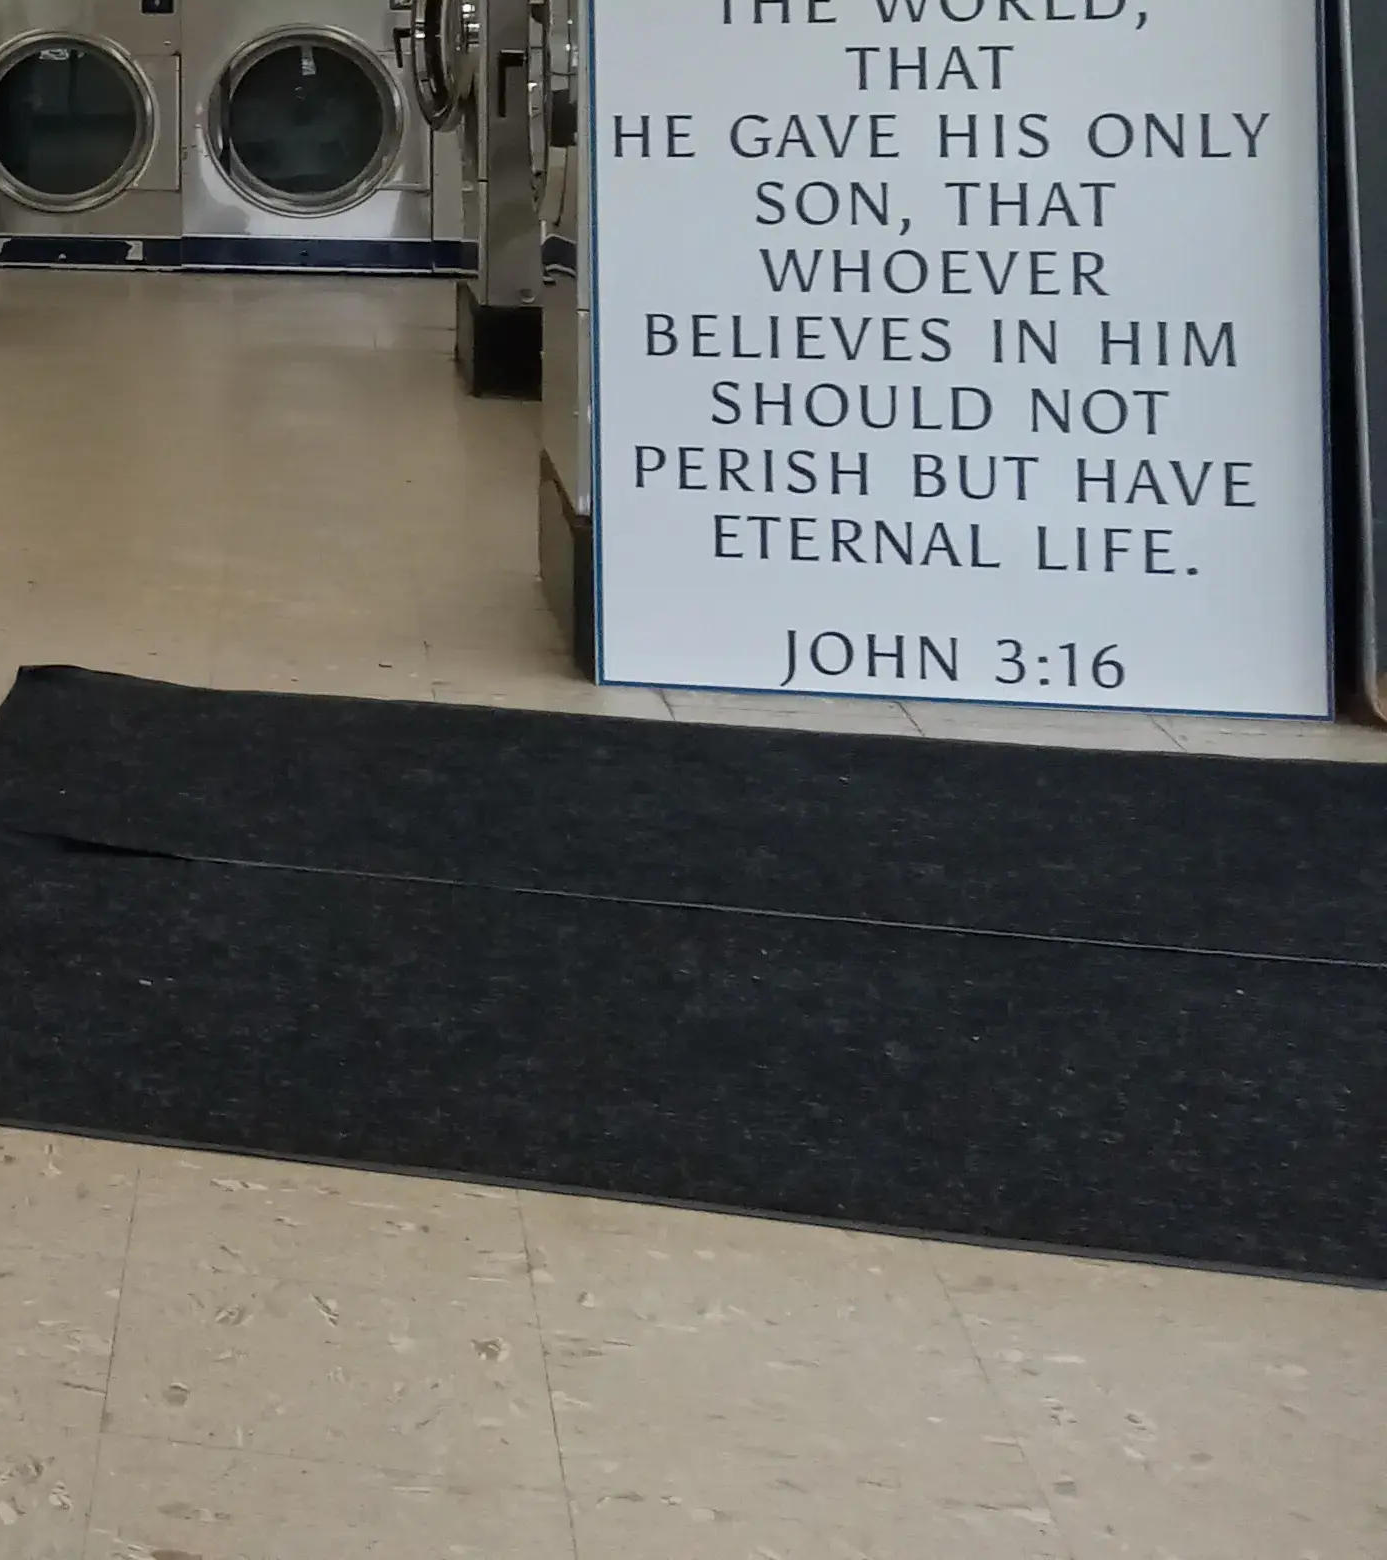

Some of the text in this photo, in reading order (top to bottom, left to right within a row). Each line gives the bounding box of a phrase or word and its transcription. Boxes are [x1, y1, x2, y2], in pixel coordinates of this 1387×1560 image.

[846, 46, 1013, 90] THAT
[614, 113, 1269, 158] HE GAVE HIS ONLY
[757, 182, 1115, 235] SON, THAT
[760, 249, 1109, 295] WHOEVER
[646, 314, 1236, 366] BELIEVES IN HIM
[712, 382, 1168, 434] SHOULD NOT
[635, 446, 1255, 507] PERISH BUT HAVE
[715, 515, 1197, 575] ETERNAL LIFE.
[781, 630, 1123, 688] JOHN 3:16
